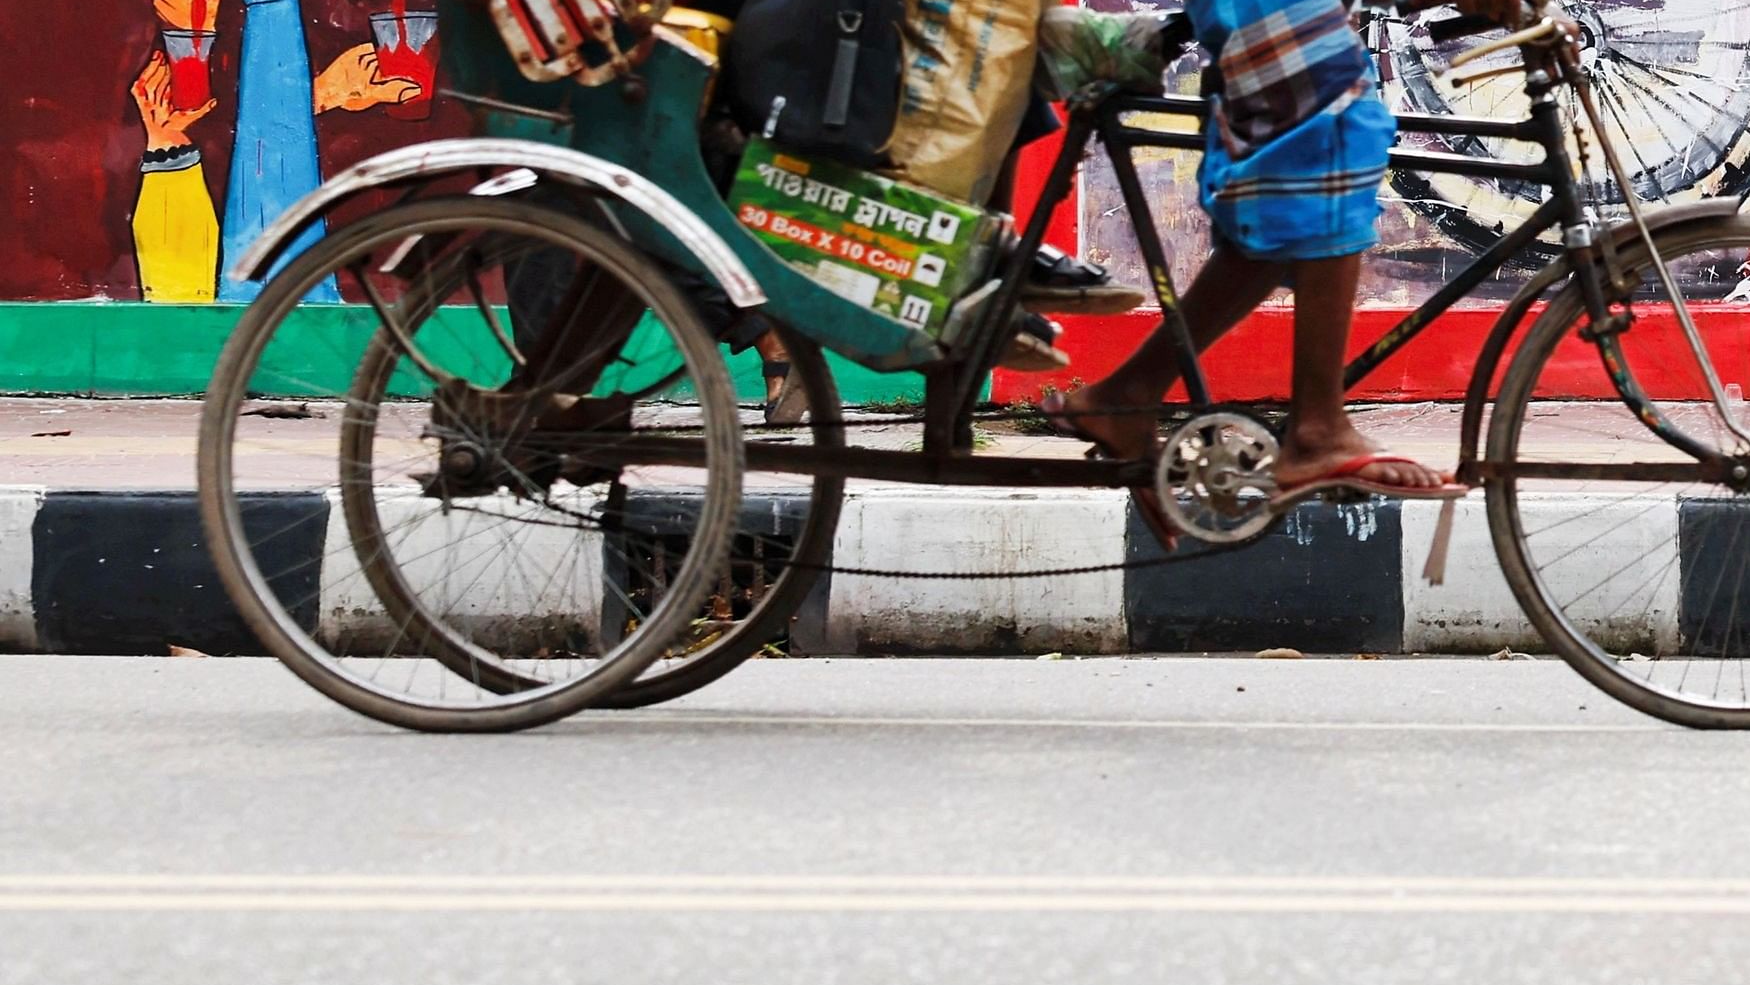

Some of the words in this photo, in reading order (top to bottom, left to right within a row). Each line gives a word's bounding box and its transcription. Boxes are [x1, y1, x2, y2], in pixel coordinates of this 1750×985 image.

[743, 206, 769, 227] 30
[770, 216, 814, 243] Box
[817, 234, 836, 251] X
[840, 239, 865, 260] 10
[867, 249, 912, 276] Coil
